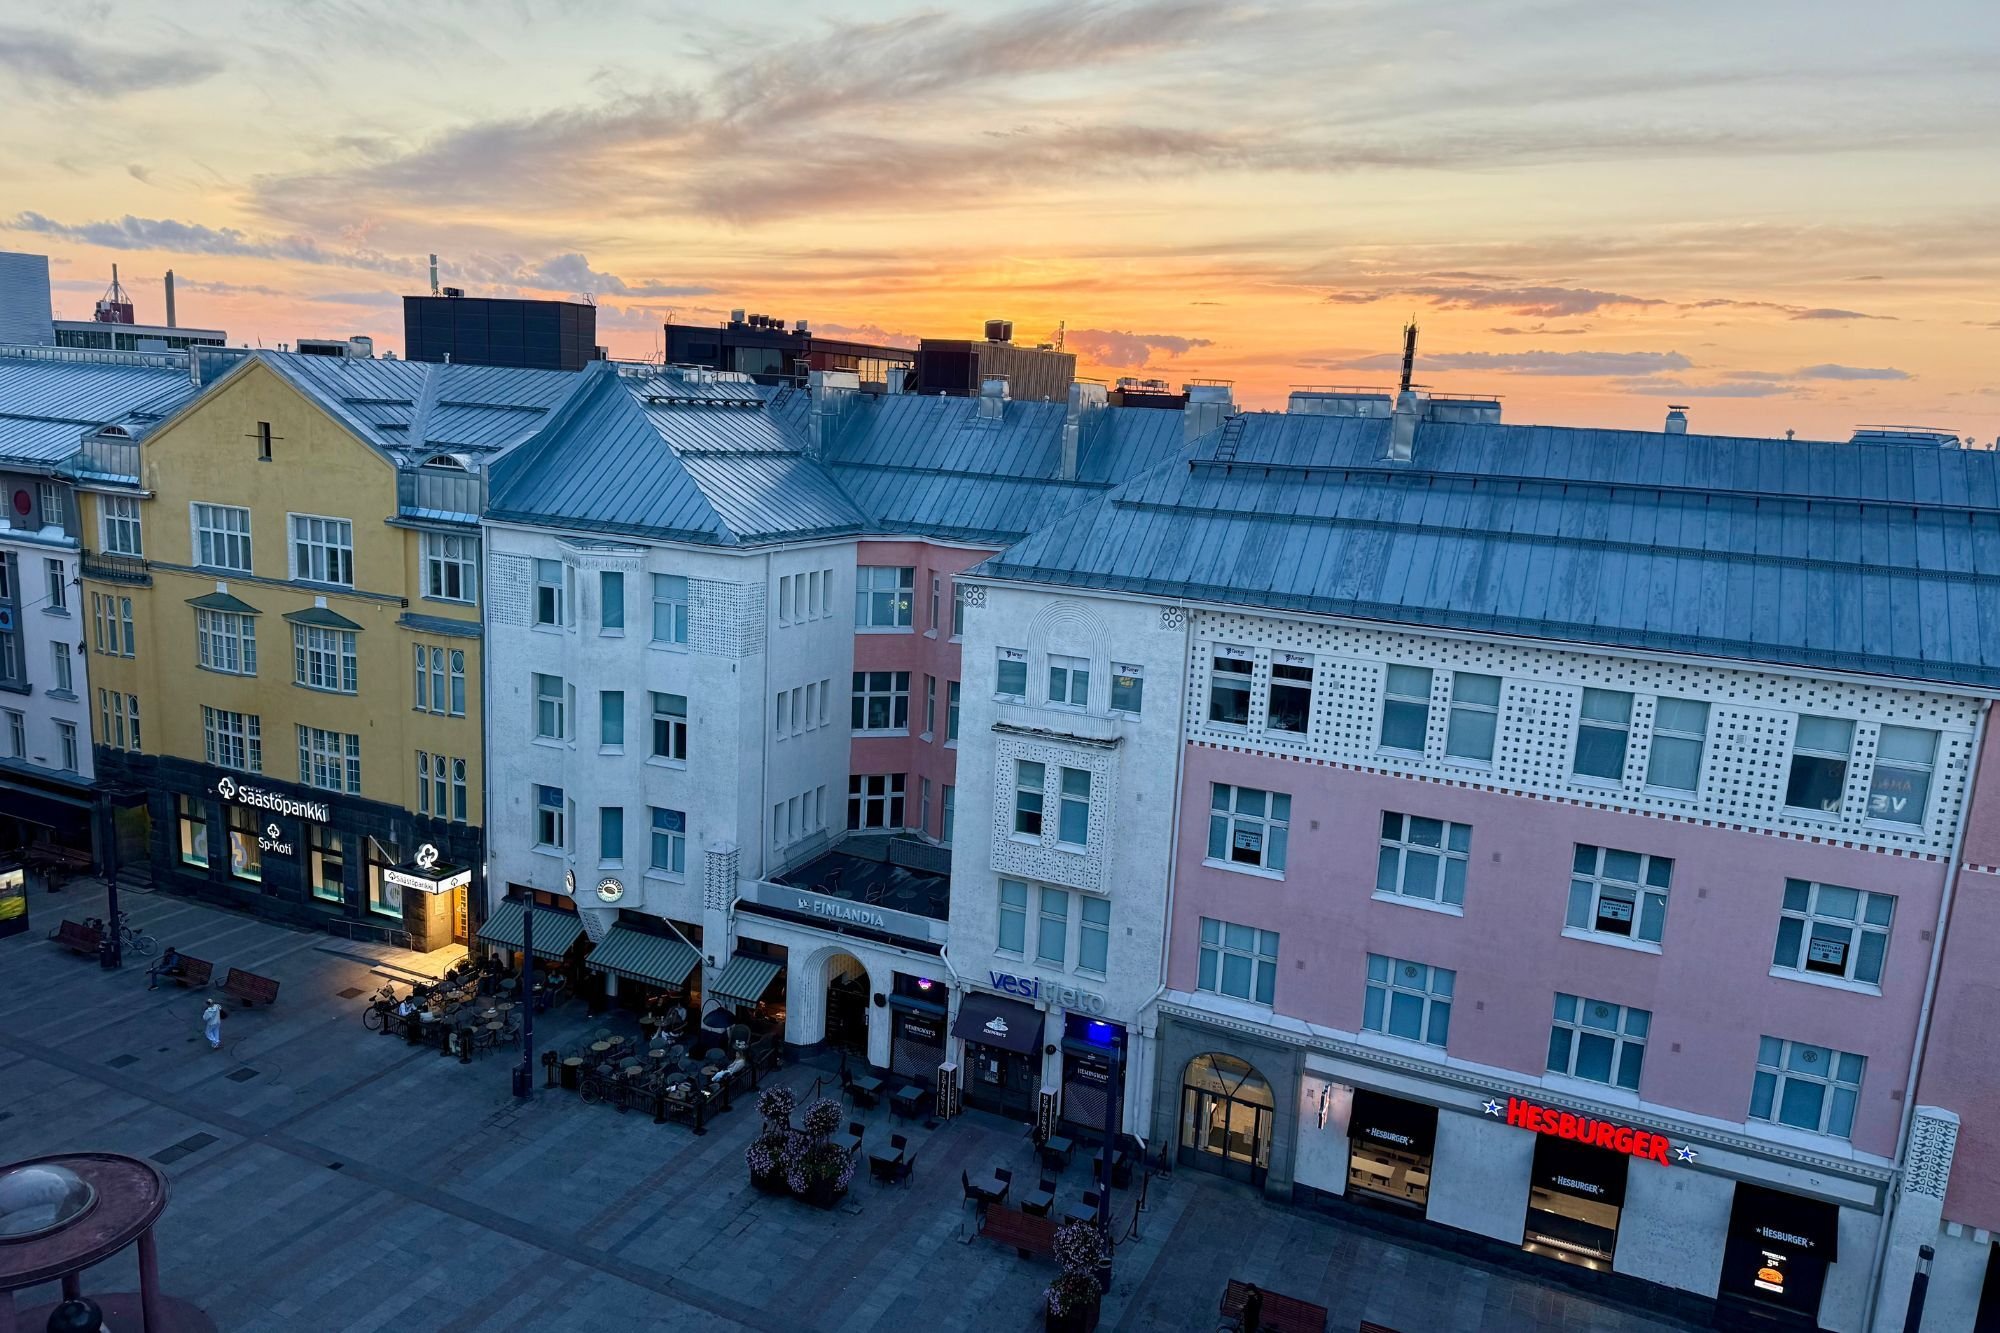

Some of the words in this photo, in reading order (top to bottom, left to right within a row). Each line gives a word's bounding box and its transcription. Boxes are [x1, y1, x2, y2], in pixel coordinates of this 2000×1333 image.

[239, 785, 327, 822] Säästöpankki
[258, 837, 292, 856] Sp-Koti
[813, 901, 885, 927] FINLANDIA
[989, 970, 1105, 1015] vesitieto
[1371, 1127, 1409, 1146] HESBURGER
[1506, 1096, 1671, 1168] HESBURGER
[1557, 1175, 1599, 1195] HESBURGER
[1762, 1226, 1808, 1249] HESBURGER
